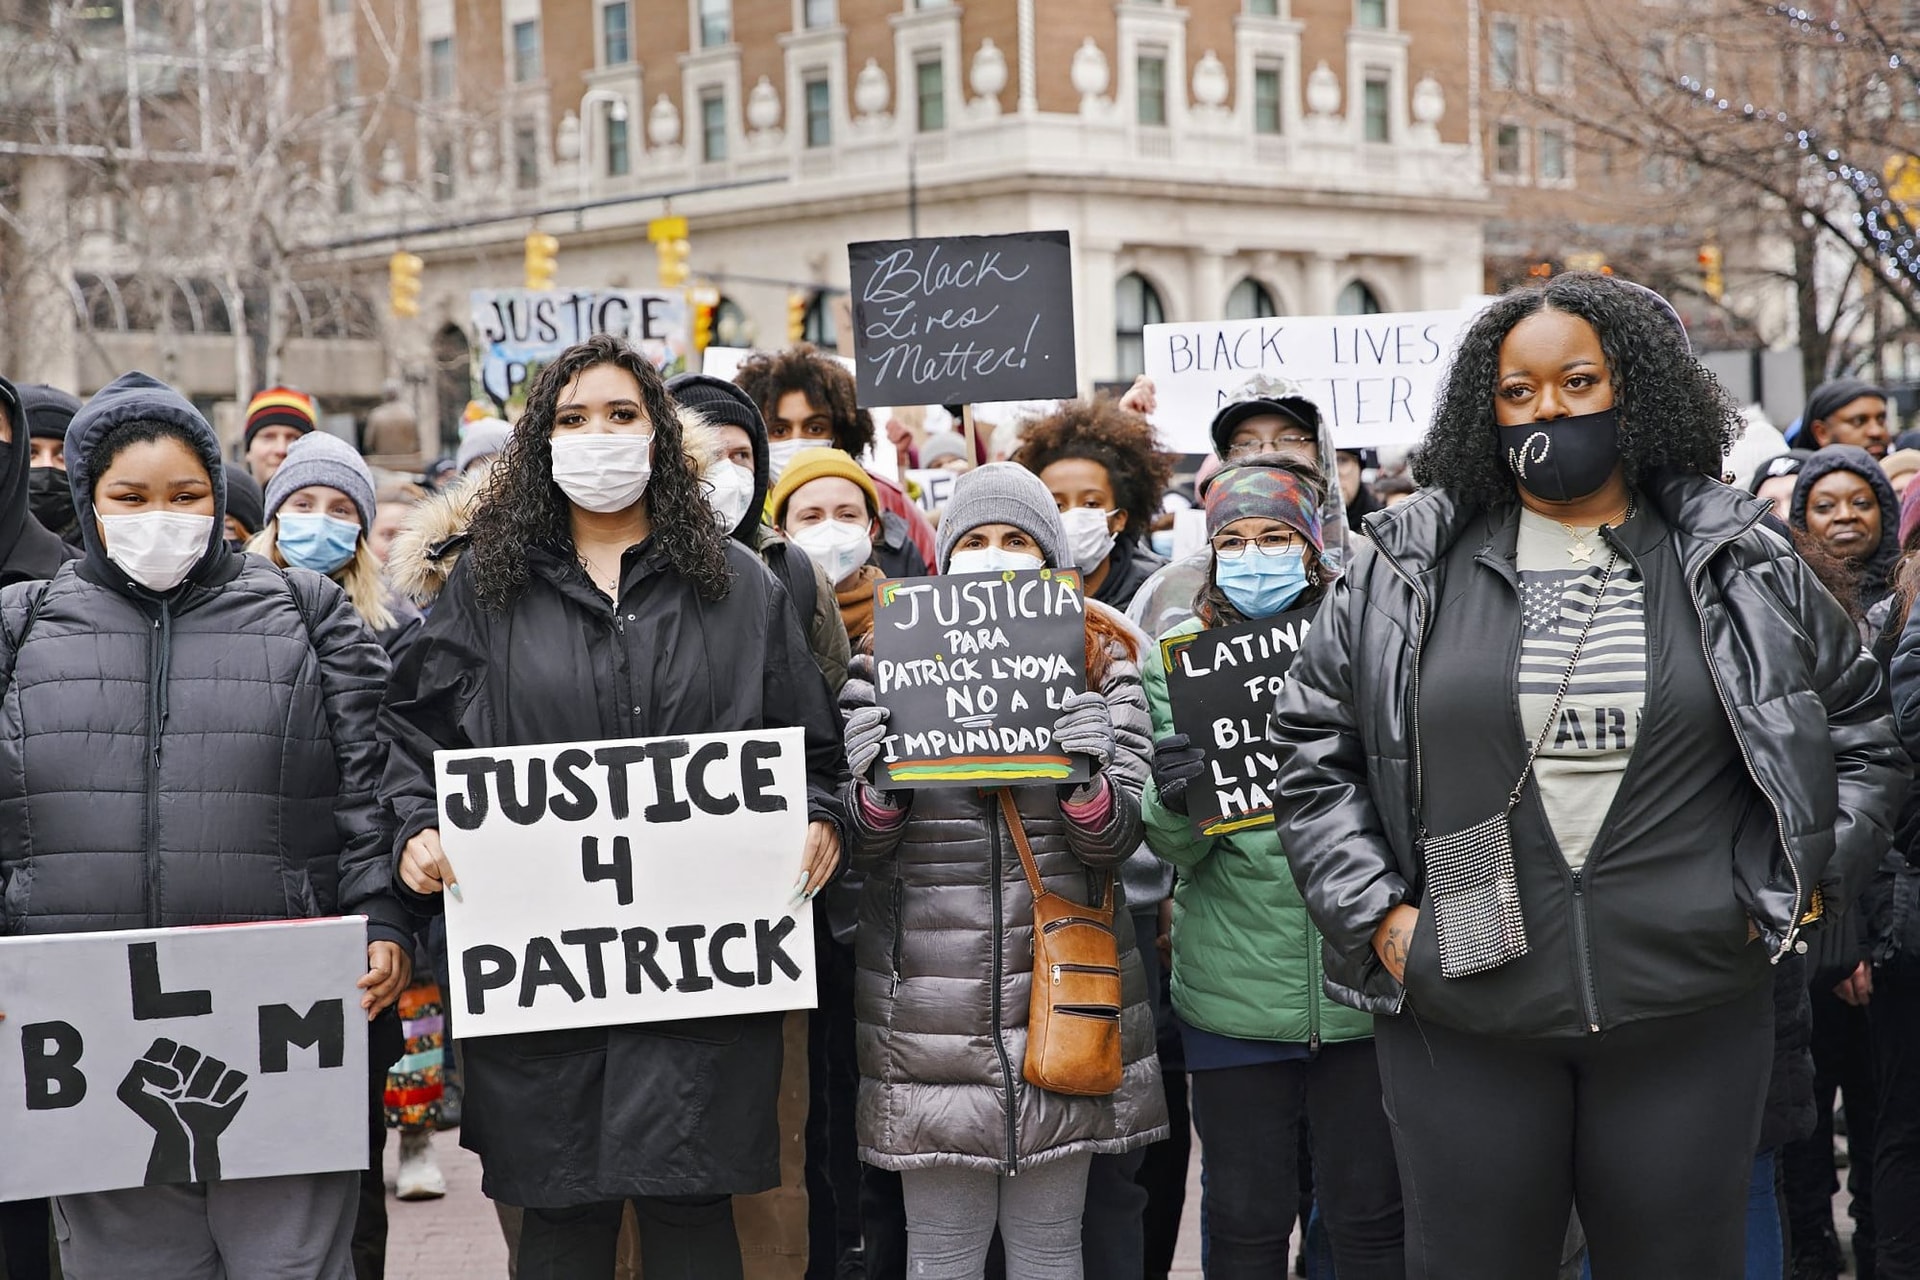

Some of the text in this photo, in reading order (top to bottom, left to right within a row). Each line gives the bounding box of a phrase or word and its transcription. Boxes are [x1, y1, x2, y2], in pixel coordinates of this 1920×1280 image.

[864, 245, 1029, 302] Black
[486, 294, 669, 345] JUSTICE
[869, 314, 1040, 386] Matter!
[1170, 324, 1440, 373] BLACK LIVES
[1217, 375, 1415, 427] TER
[893, 573, 1082, 630] JUSTICIA
[943, 627, 1010, 654] PARA
[877, 653, 1077, 694] PATRICK LYOYA
[1244, 670, 1289, 702] FO
[946, 685, 998, 718] NO
[1011, 689, 1029, 712] A
[880, 726, 1051, 763] IMPUNIDAD
[1554, 707, 1642, 750] AR
[445, 739, 788, 830] JUSTICE
[582, 835, 634, 906] 4
[462, 915, 802, 1015] PATRICK
